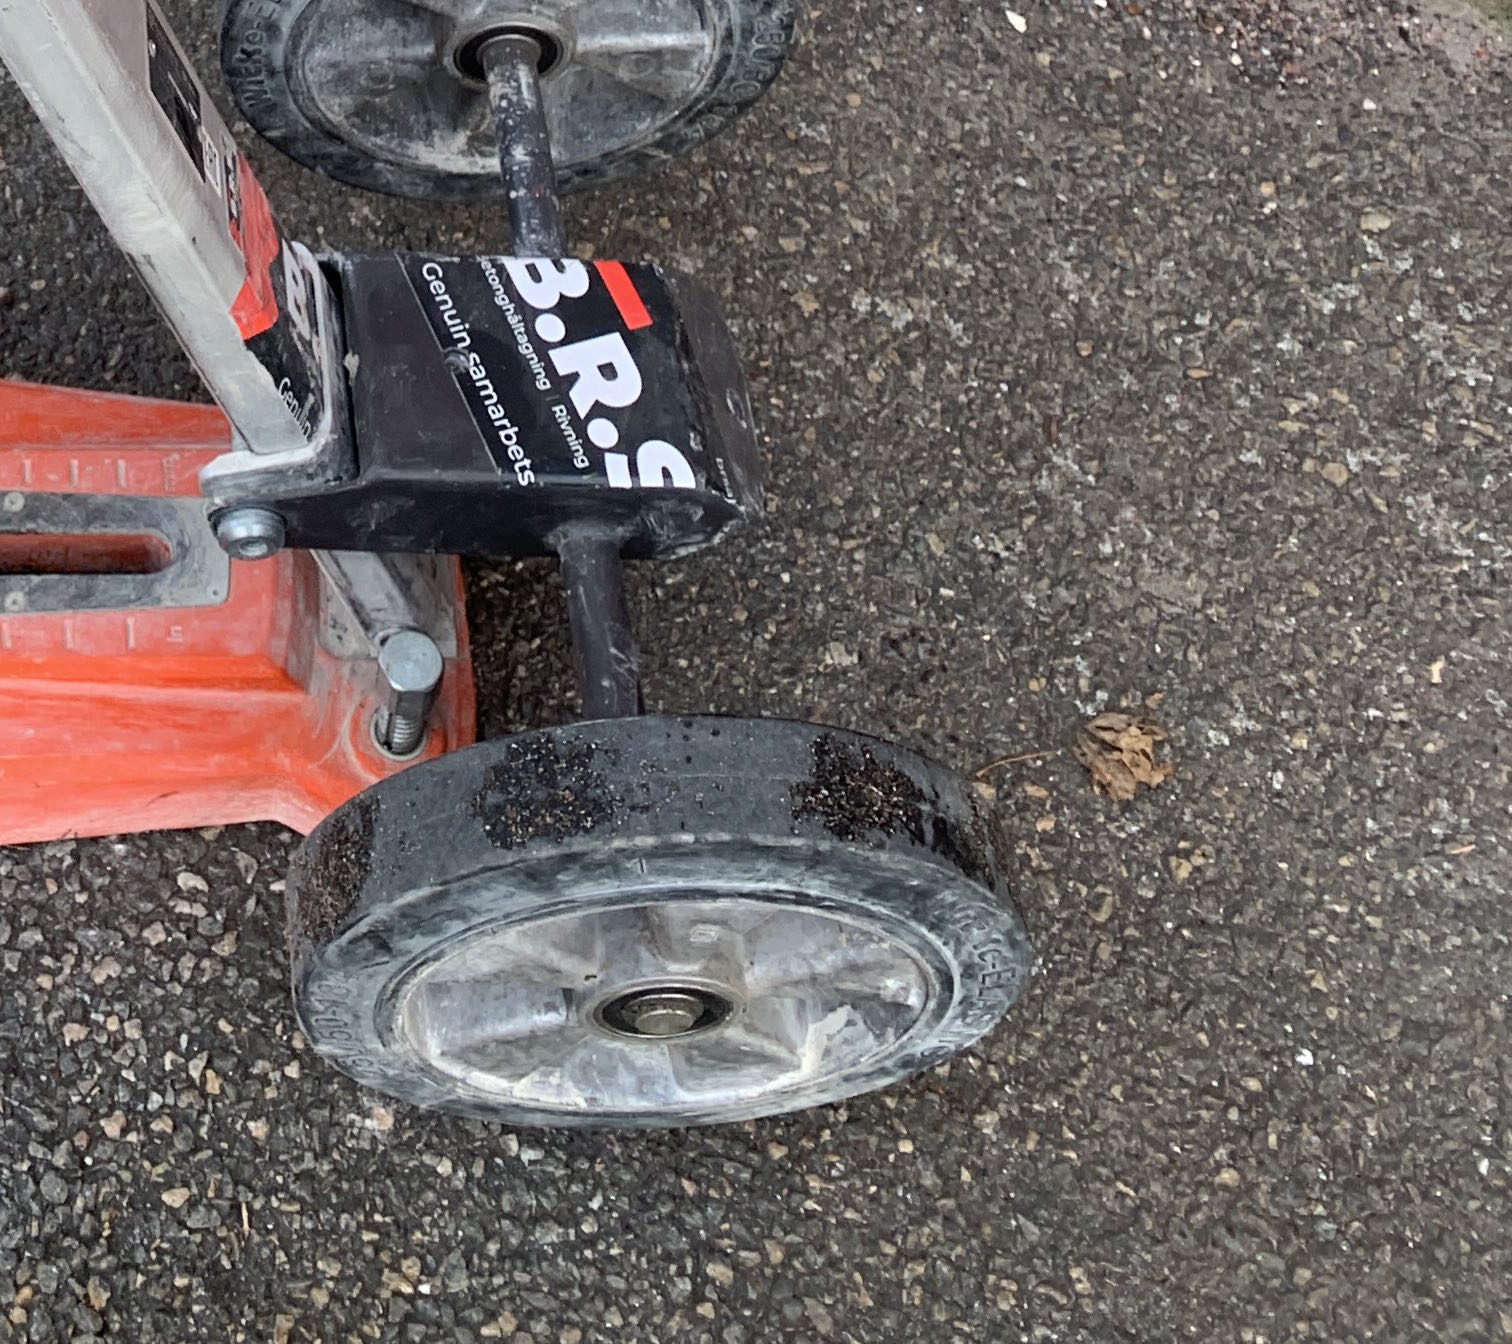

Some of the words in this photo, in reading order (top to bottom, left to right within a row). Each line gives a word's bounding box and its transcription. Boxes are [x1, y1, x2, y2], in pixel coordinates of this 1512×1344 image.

[421, 261, 472, 351] Genuin
[467, 350, 536, 488] samarbets
[552, 403, 590, 470] Rivning
